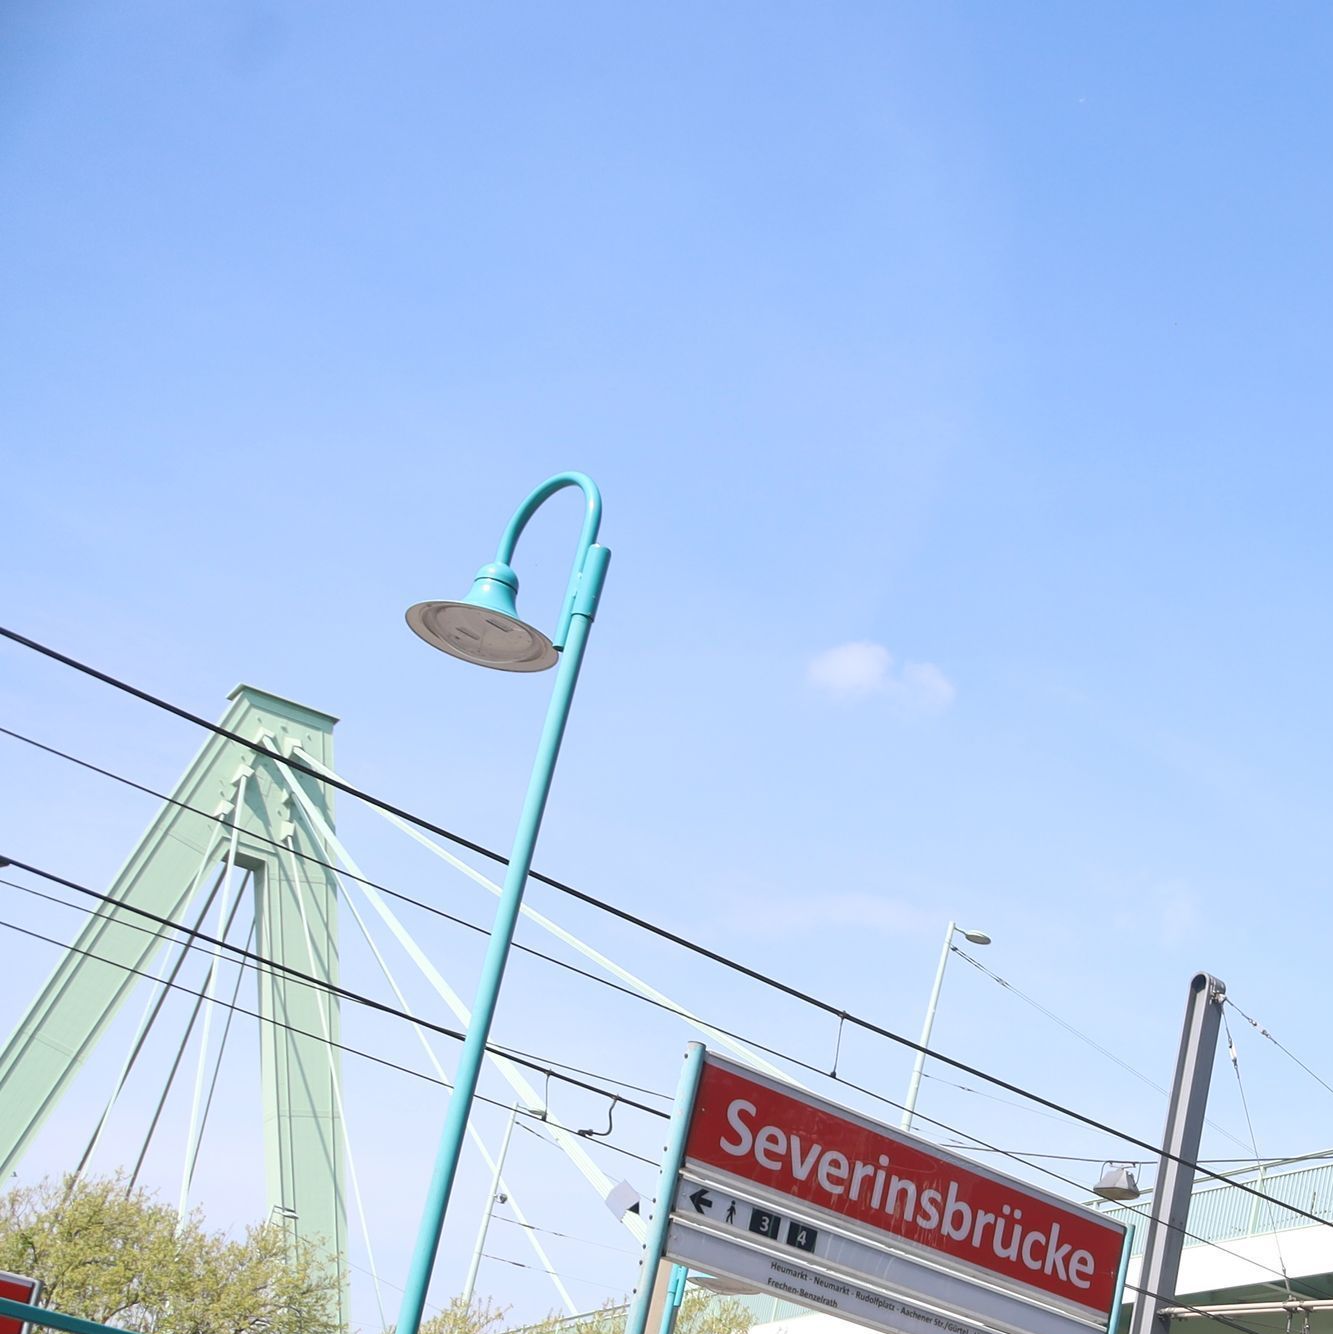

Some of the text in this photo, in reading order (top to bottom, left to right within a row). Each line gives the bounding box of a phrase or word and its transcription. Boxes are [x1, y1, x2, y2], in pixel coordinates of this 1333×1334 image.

[719, 1098, 1096, 1289] Severinsbrücke
[759, 1216, 807, 1246] 3 4
[767, 1277, 838, 1308] Frechen-Benzelrath
[770, 1261, 808, 1281] Heumarkt
[813, 1276, 850, 1296] Neumarkt
[855, 1290, 895, 1311] Rudolfplatz
[900, 1307, 933, 1324] Aachener
